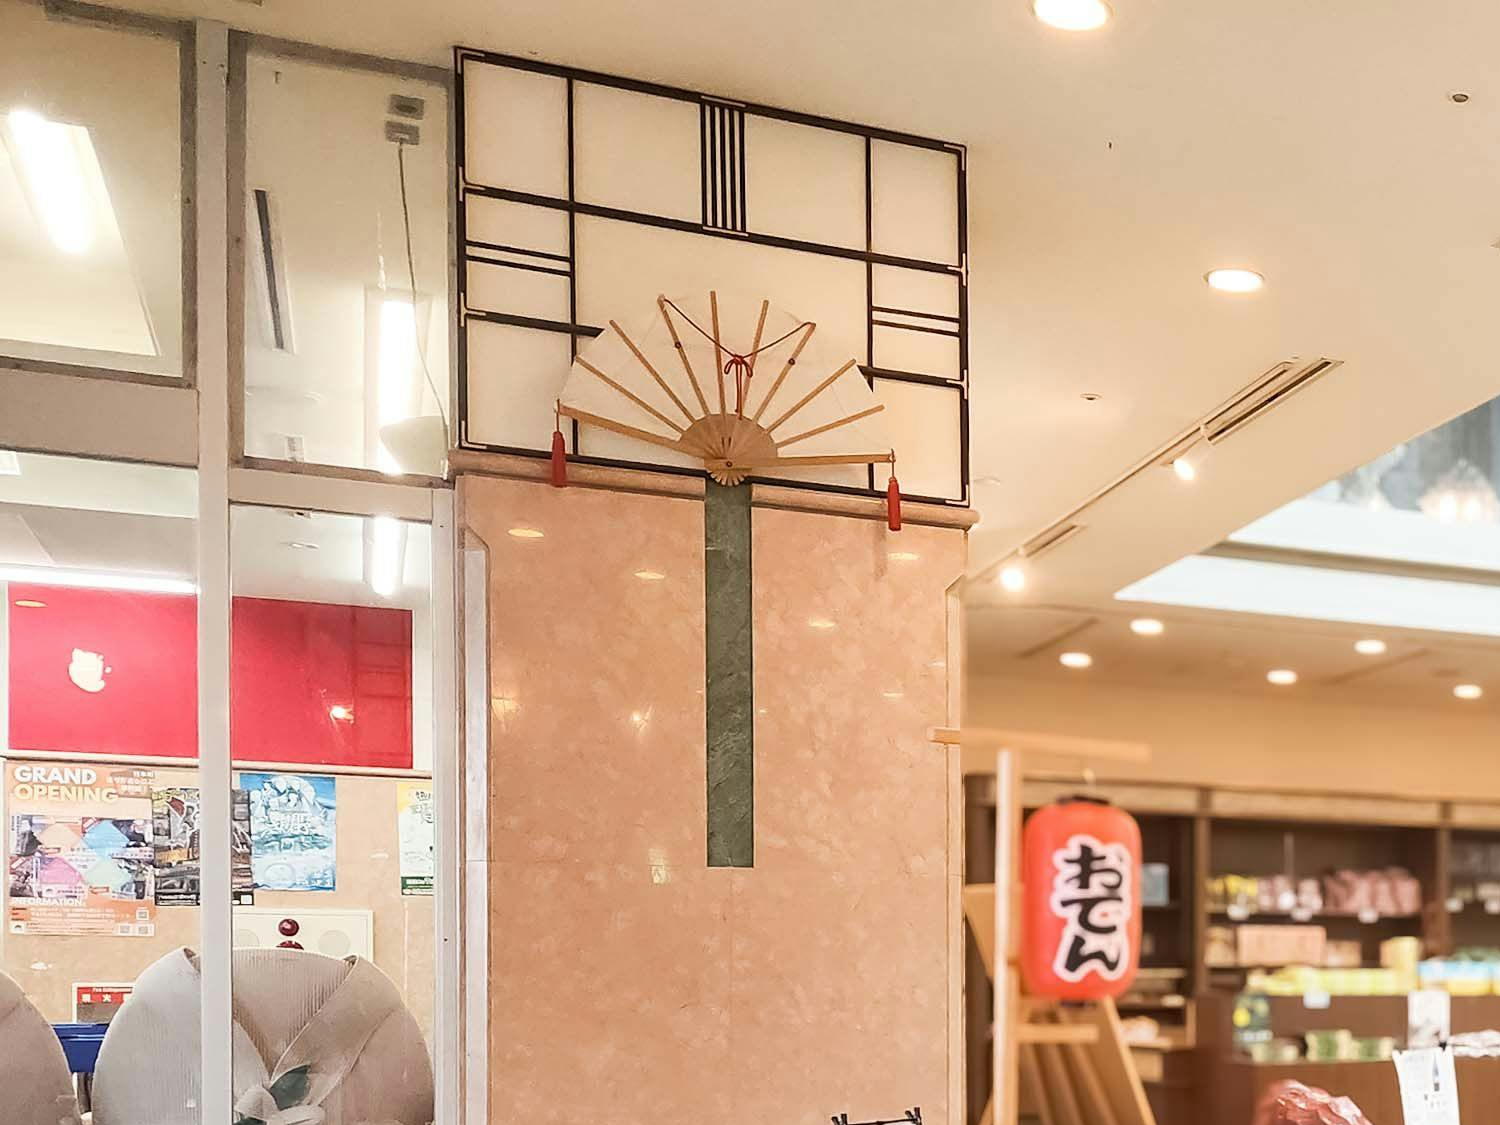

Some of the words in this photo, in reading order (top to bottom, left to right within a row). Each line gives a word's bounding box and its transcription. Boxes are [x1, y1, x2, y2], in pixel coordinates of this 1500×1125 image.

[14, 765, 97, 785] GRAND
[14, 784, 119, 803] OPENING
[1060, 843, 1124, 973] おでん
